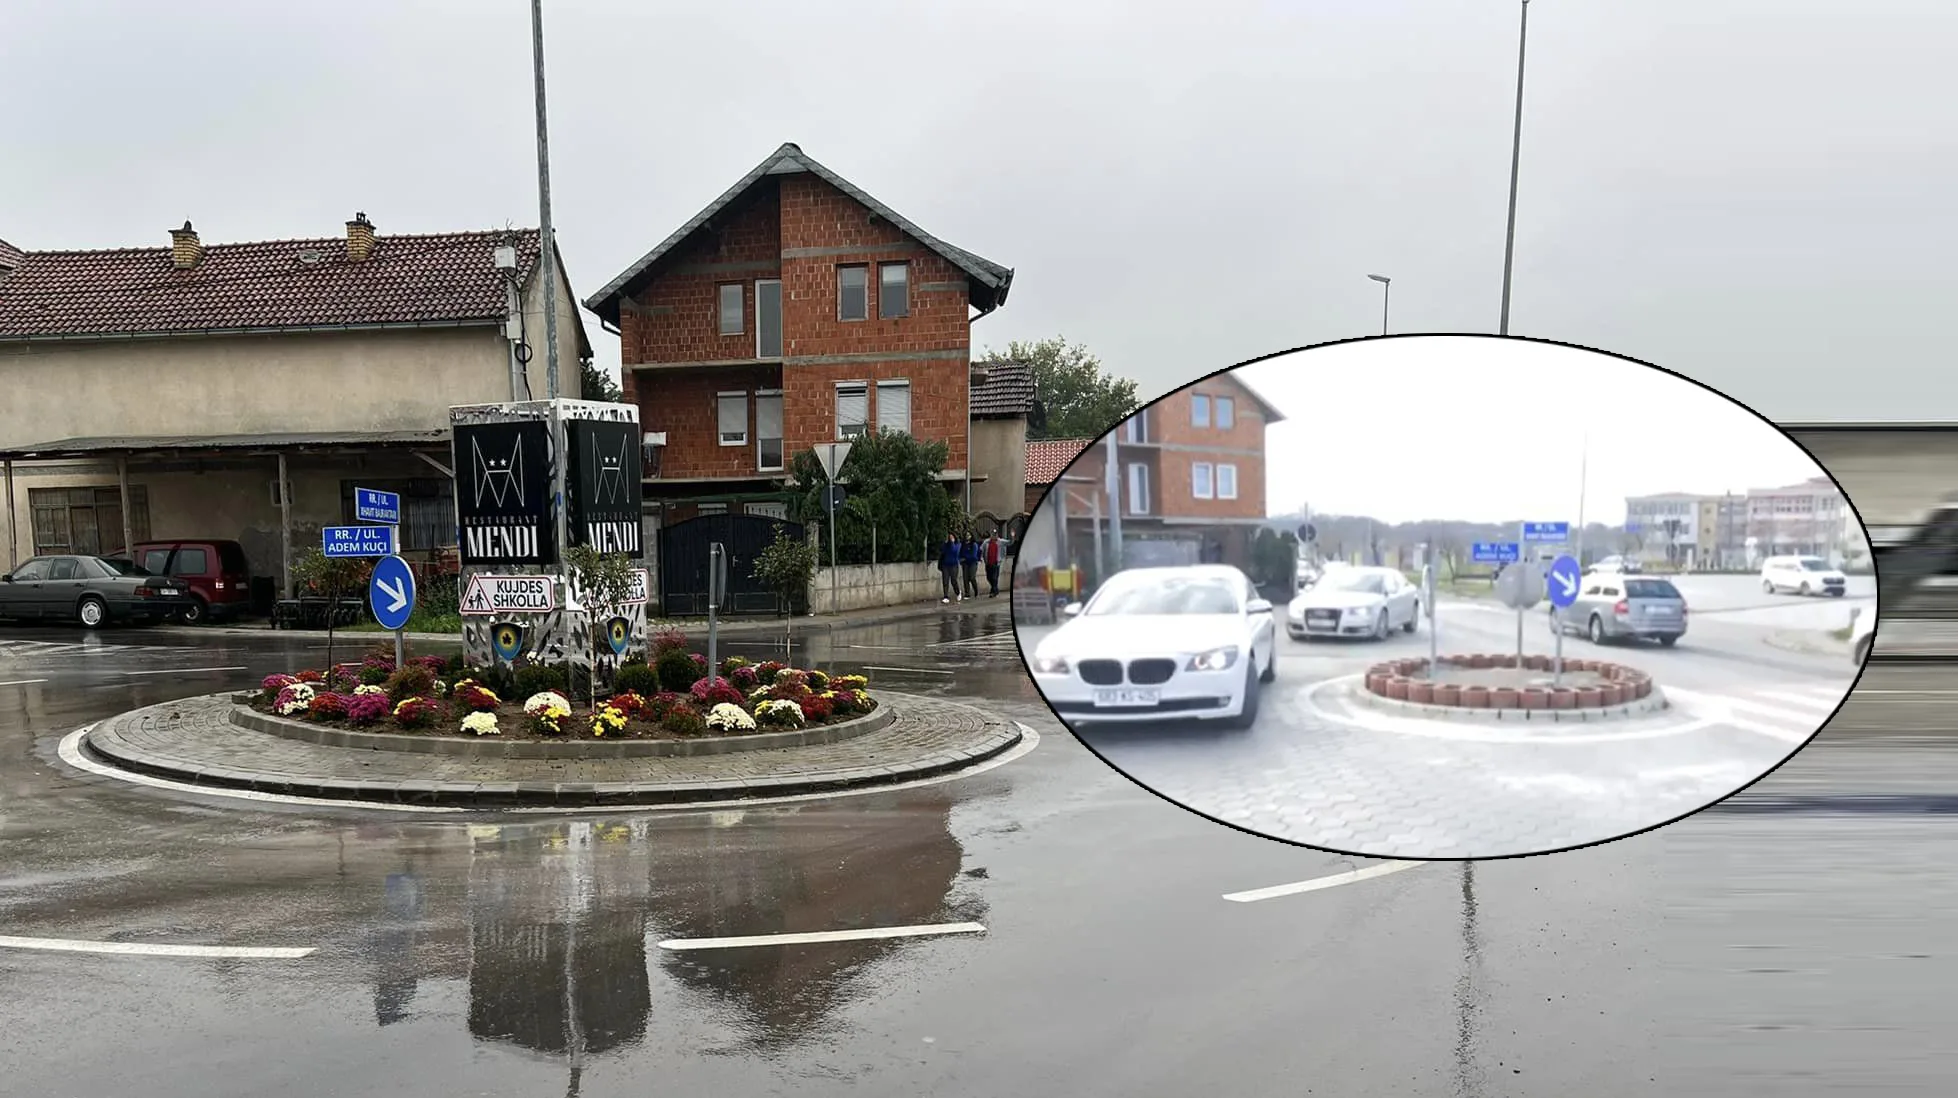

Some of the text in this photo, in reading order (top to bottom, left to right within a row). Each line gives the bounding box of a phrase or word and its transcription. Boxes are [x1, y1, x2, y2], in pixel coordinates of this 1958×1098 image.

[464, 515, 538, 525] RESTAURANT
[335, 528, 381, 541] RR. / UL.
[466, 525, 539, 558] MENDI
[587, 521, 639, 553] MENDI
[328, 541, 387, 553] ADEM KUÇI
[496, 580, 543, 594] KUJDES
[493, 594, 549, 608] SHKOLLA
